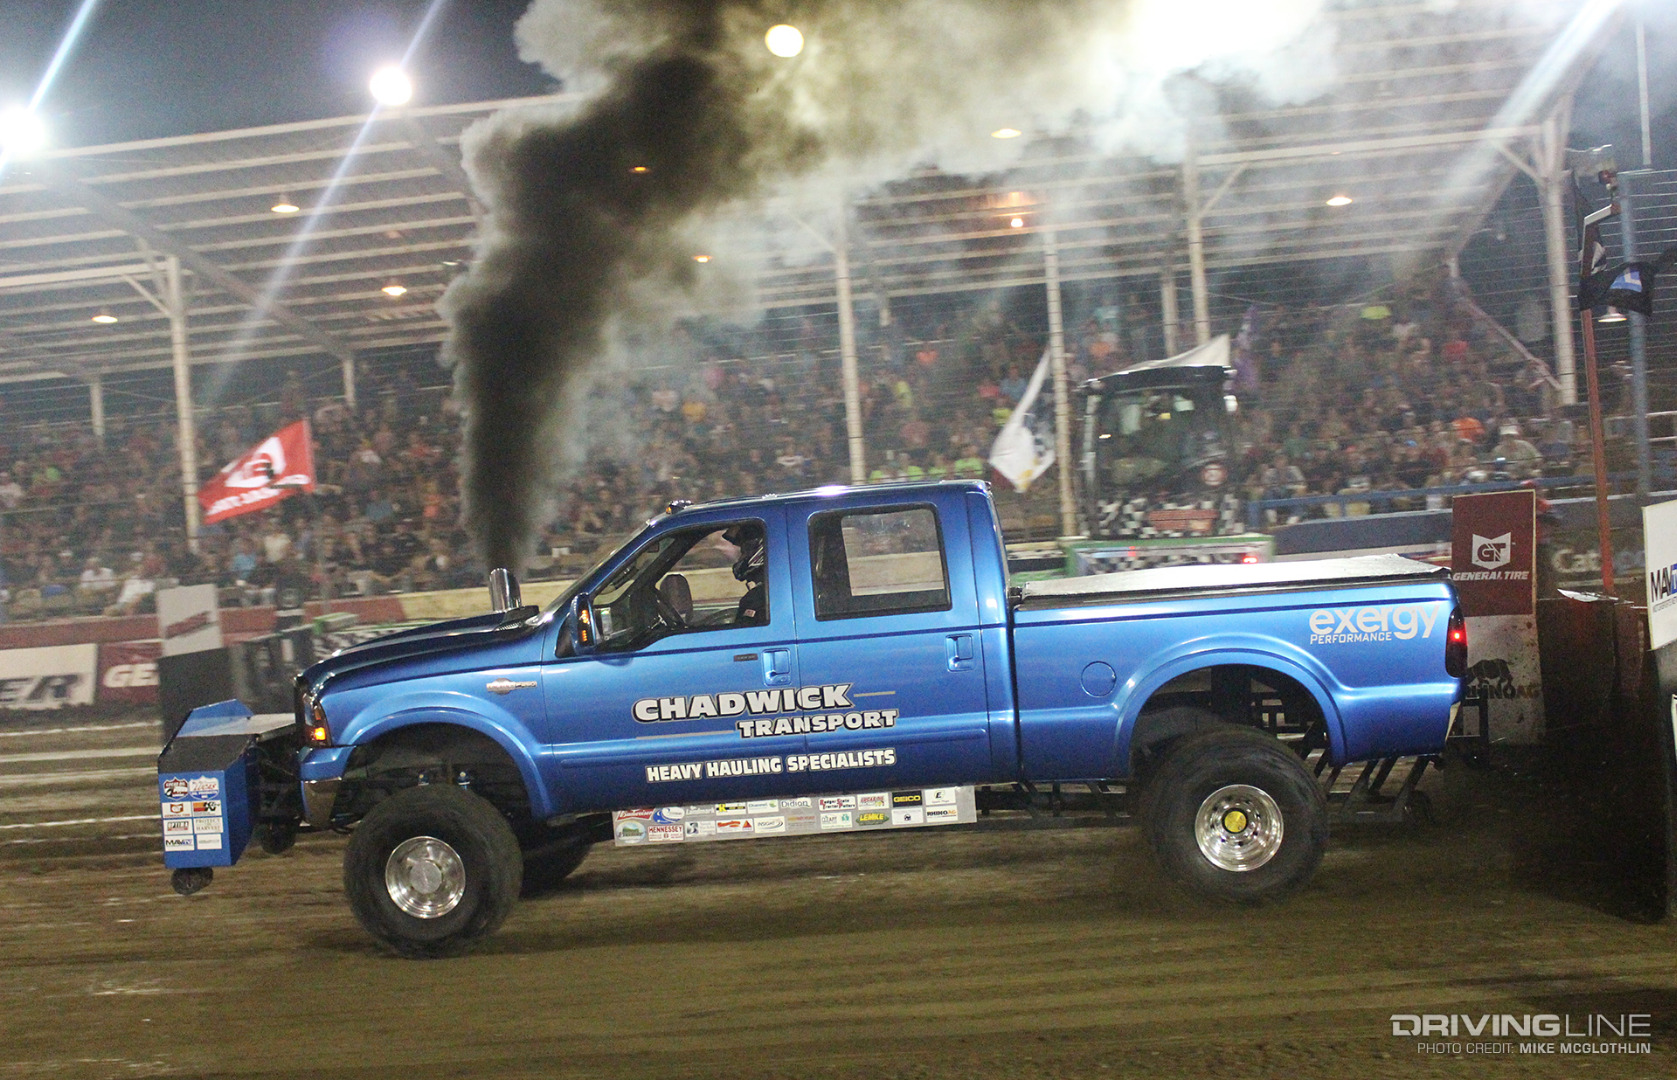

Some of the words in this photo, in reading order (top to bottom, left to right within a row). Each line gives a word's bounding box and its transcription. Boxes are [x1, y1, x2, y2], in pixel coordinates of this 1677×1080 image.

[1452, 571, 1501, 581] GENERAL
[1503, 571, 1530, 581] TIRE
[1309, 604, 1440, 640] exergy
[1309, 631, 1393, 645] PERFORMANCE
[632, 683, 854, 723] CHADWICK
[736, 709, 898, 739] TRANSPORT
[646, 763, 703, 783] HEAVY
[706, 755, 782, 778] HAULING
[786, 748, 896, 773] SPECIALISTS
[893, 795, 921, 803] GEICO
